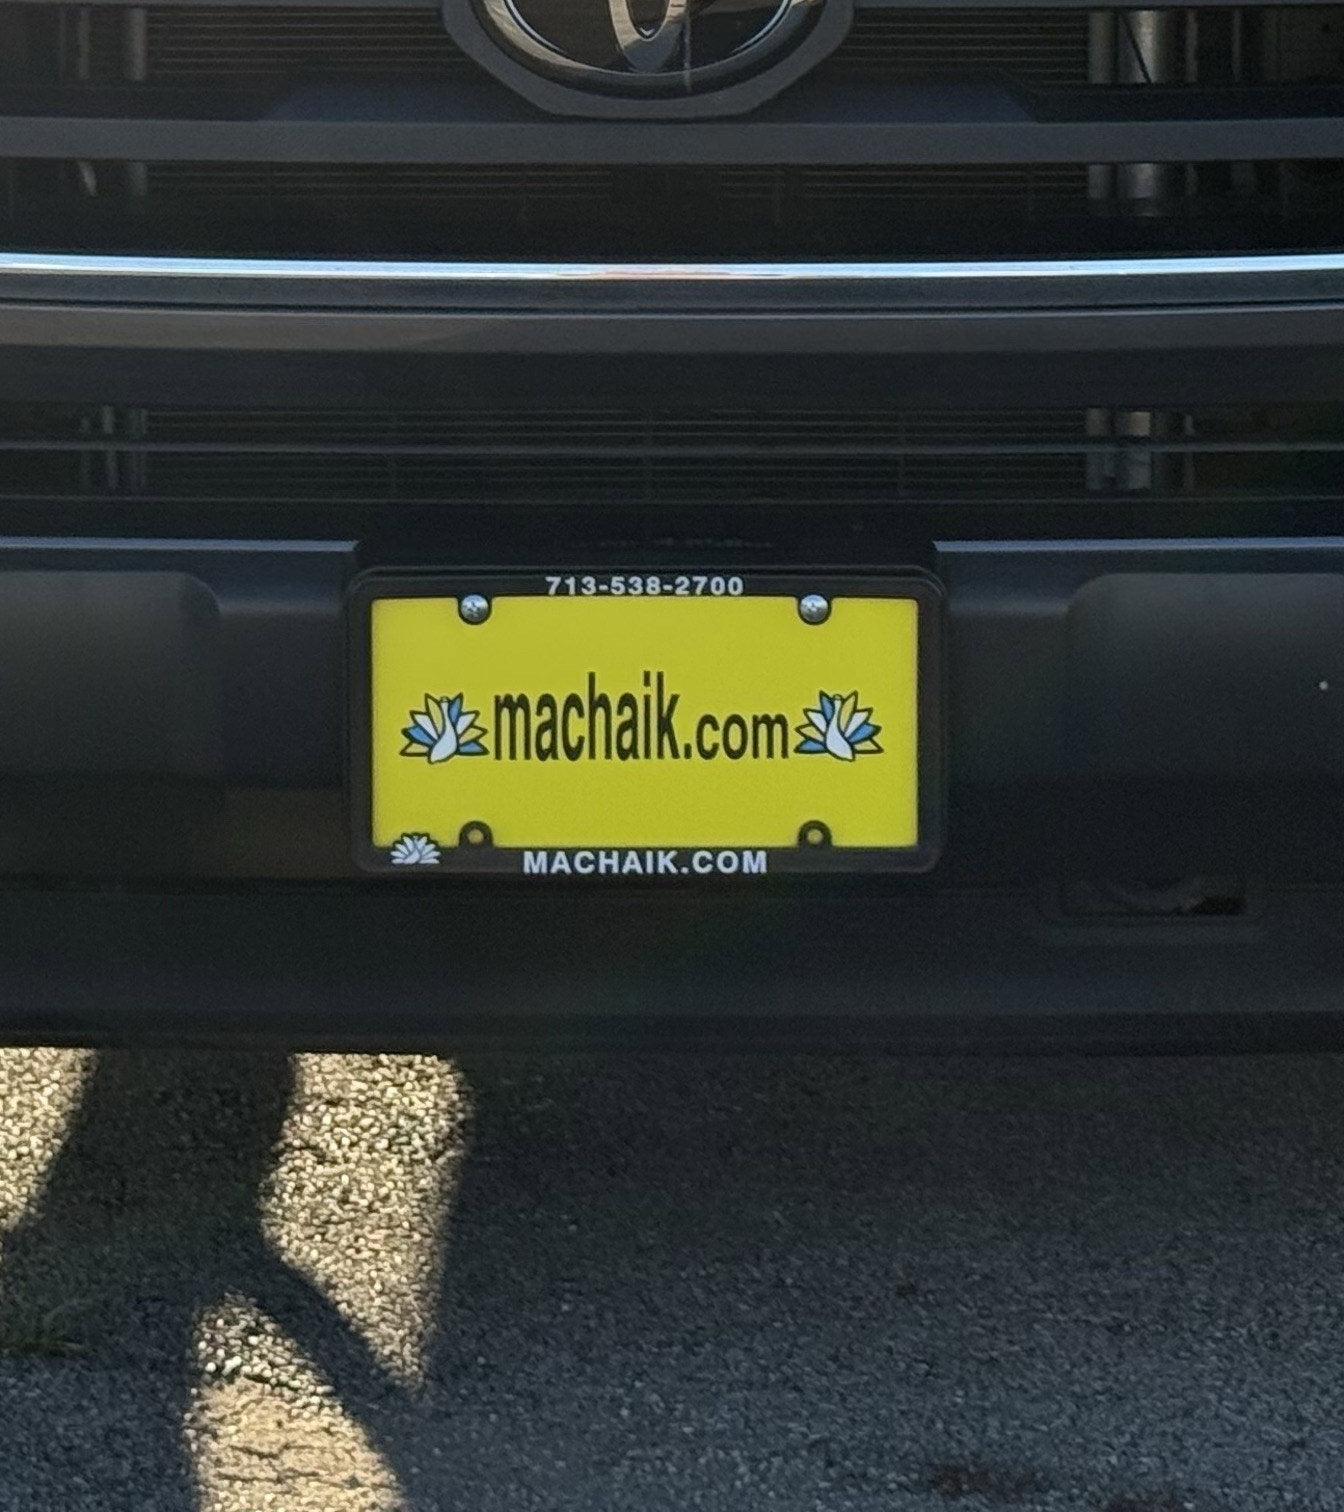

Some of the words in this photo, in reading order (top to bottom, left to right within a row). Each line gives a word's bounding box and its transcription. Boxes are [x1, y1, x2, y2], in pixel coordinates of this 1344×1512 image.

[545, 576, 744, 596] 713-538-2700
[493, 670, 790, 761] machaik.com
[522, 850, 768, 875] MACHAIK.COM
